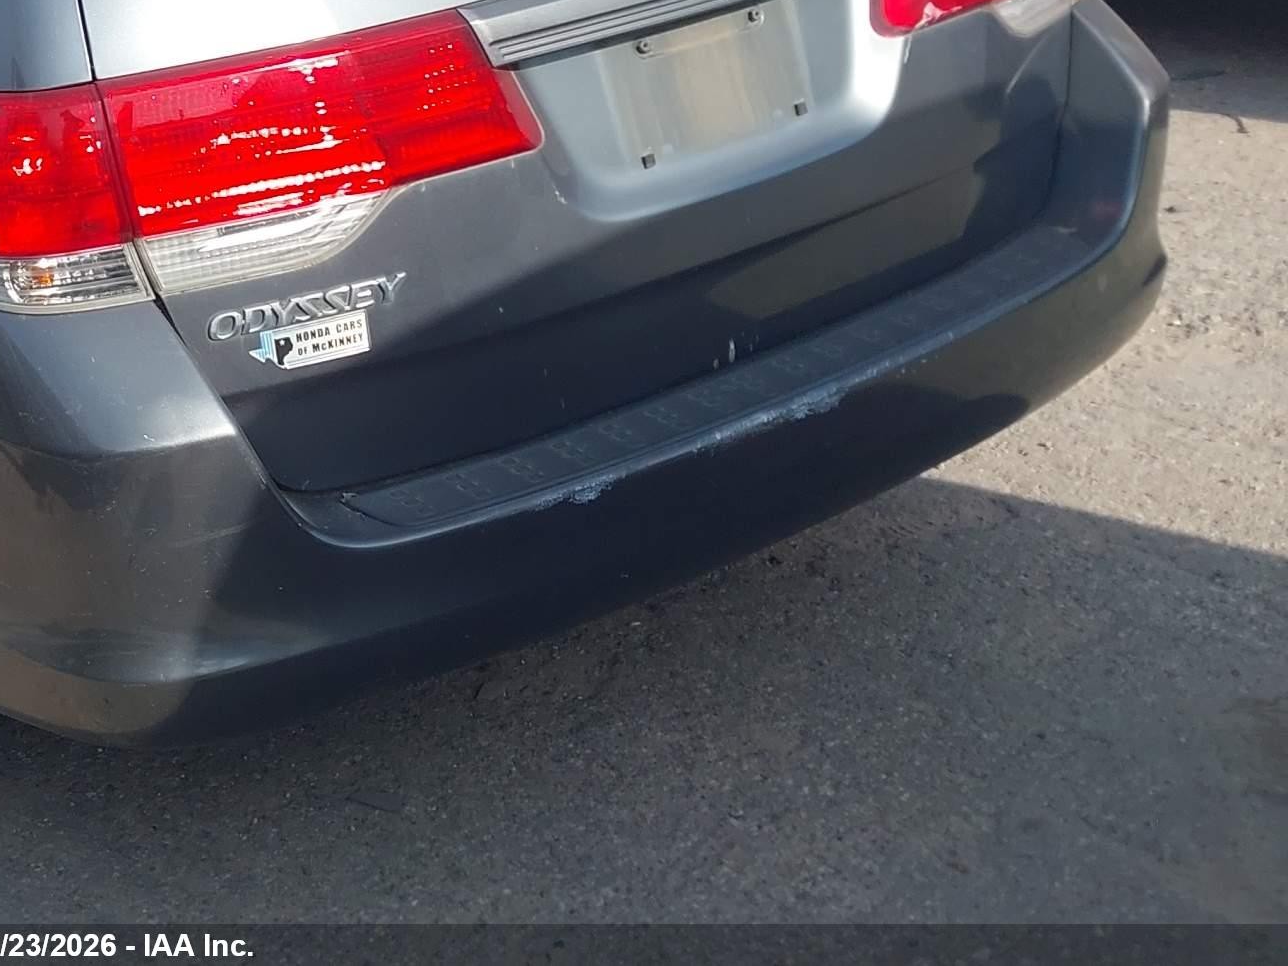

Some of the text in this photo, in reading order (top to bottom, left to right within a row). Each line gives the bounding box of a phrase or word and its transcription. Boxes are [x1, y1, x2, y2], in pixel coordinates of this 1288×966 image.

[208, 272, 407, 341] ODYSSEY
[296, 319, 363, 343] HONDA CARS
[297, 333, 363, 356] OF McKINNEY
